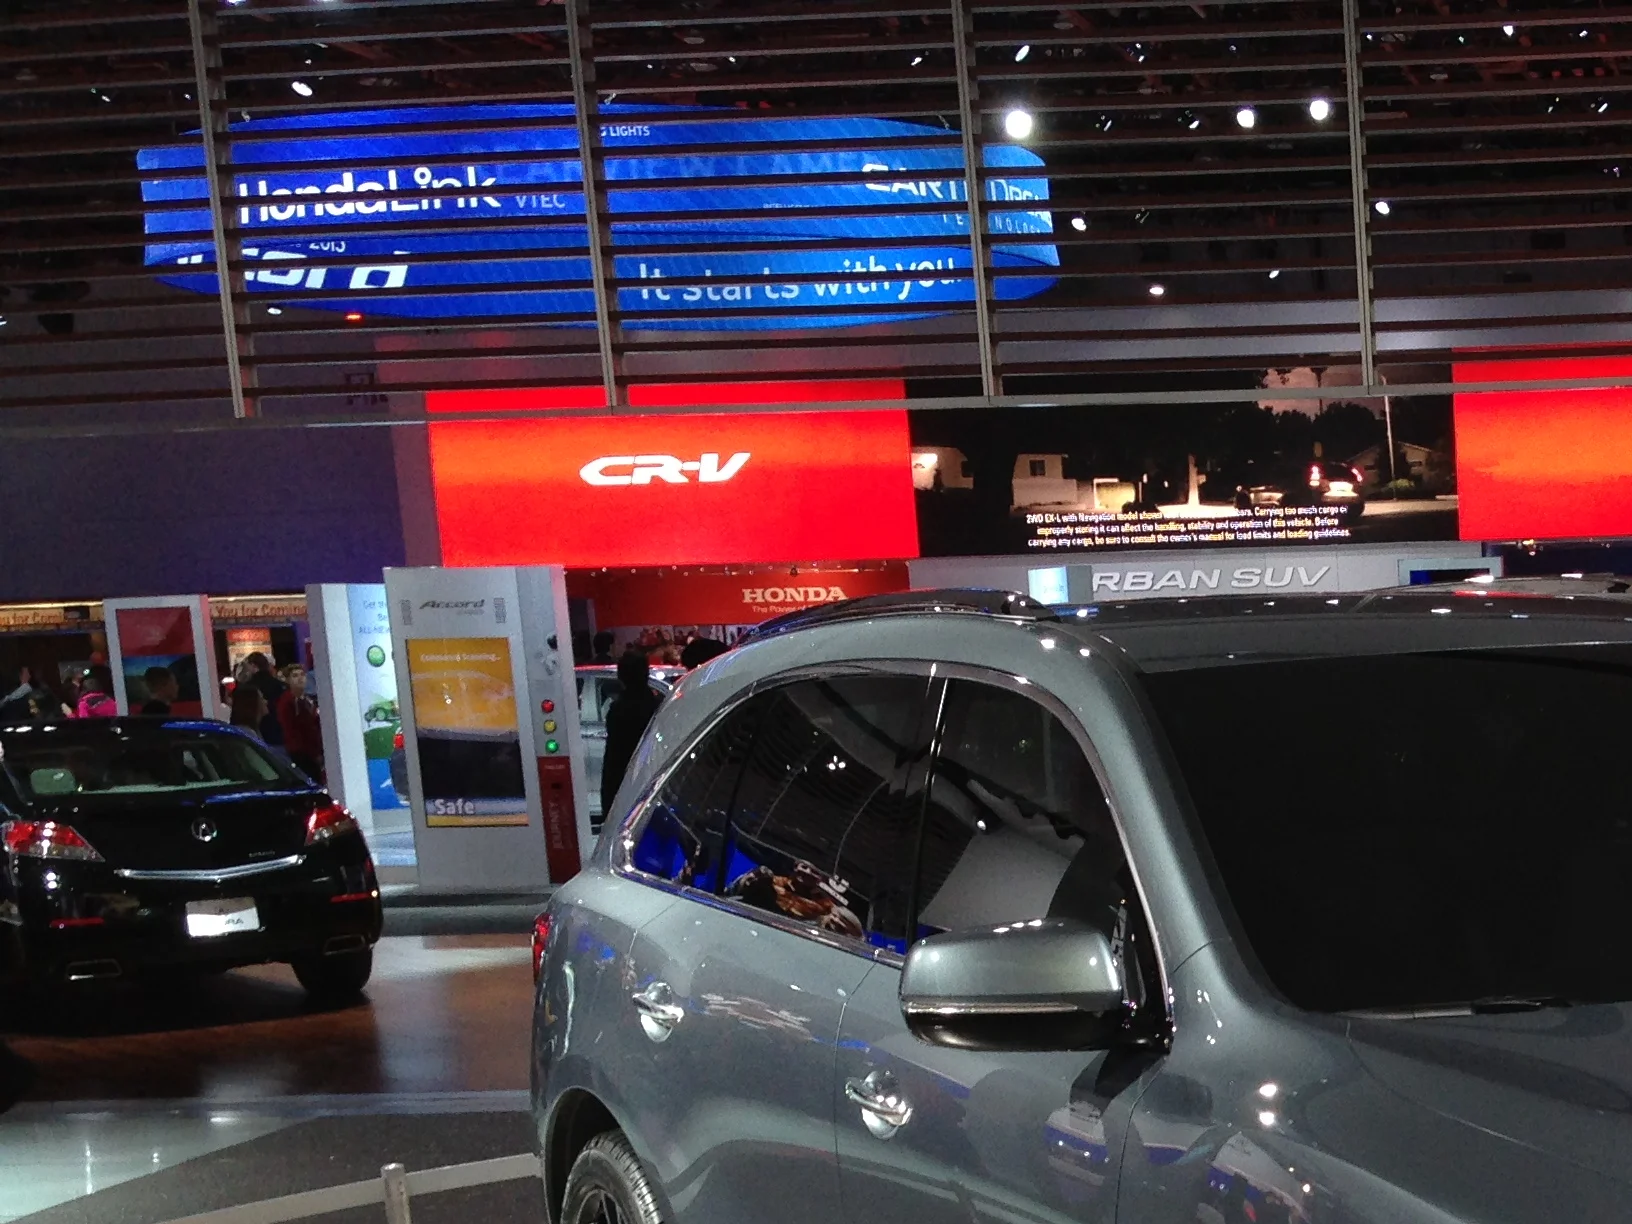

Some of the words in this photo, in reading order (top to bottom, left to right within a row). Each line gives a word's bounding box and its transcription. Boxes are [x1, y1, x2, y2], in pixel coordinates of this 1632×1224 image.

[610, 125, 650, 137] LIGHTS
[639, 262, 670, 302] It
[580, 453, 750, 486] CR-V
[1092, 567, 1221, 592] RBAN
[1231, 566, 1331, 588] SUV
[742, 586, 849, 605] HONDA
[434, 798, 476, 815] Safe
